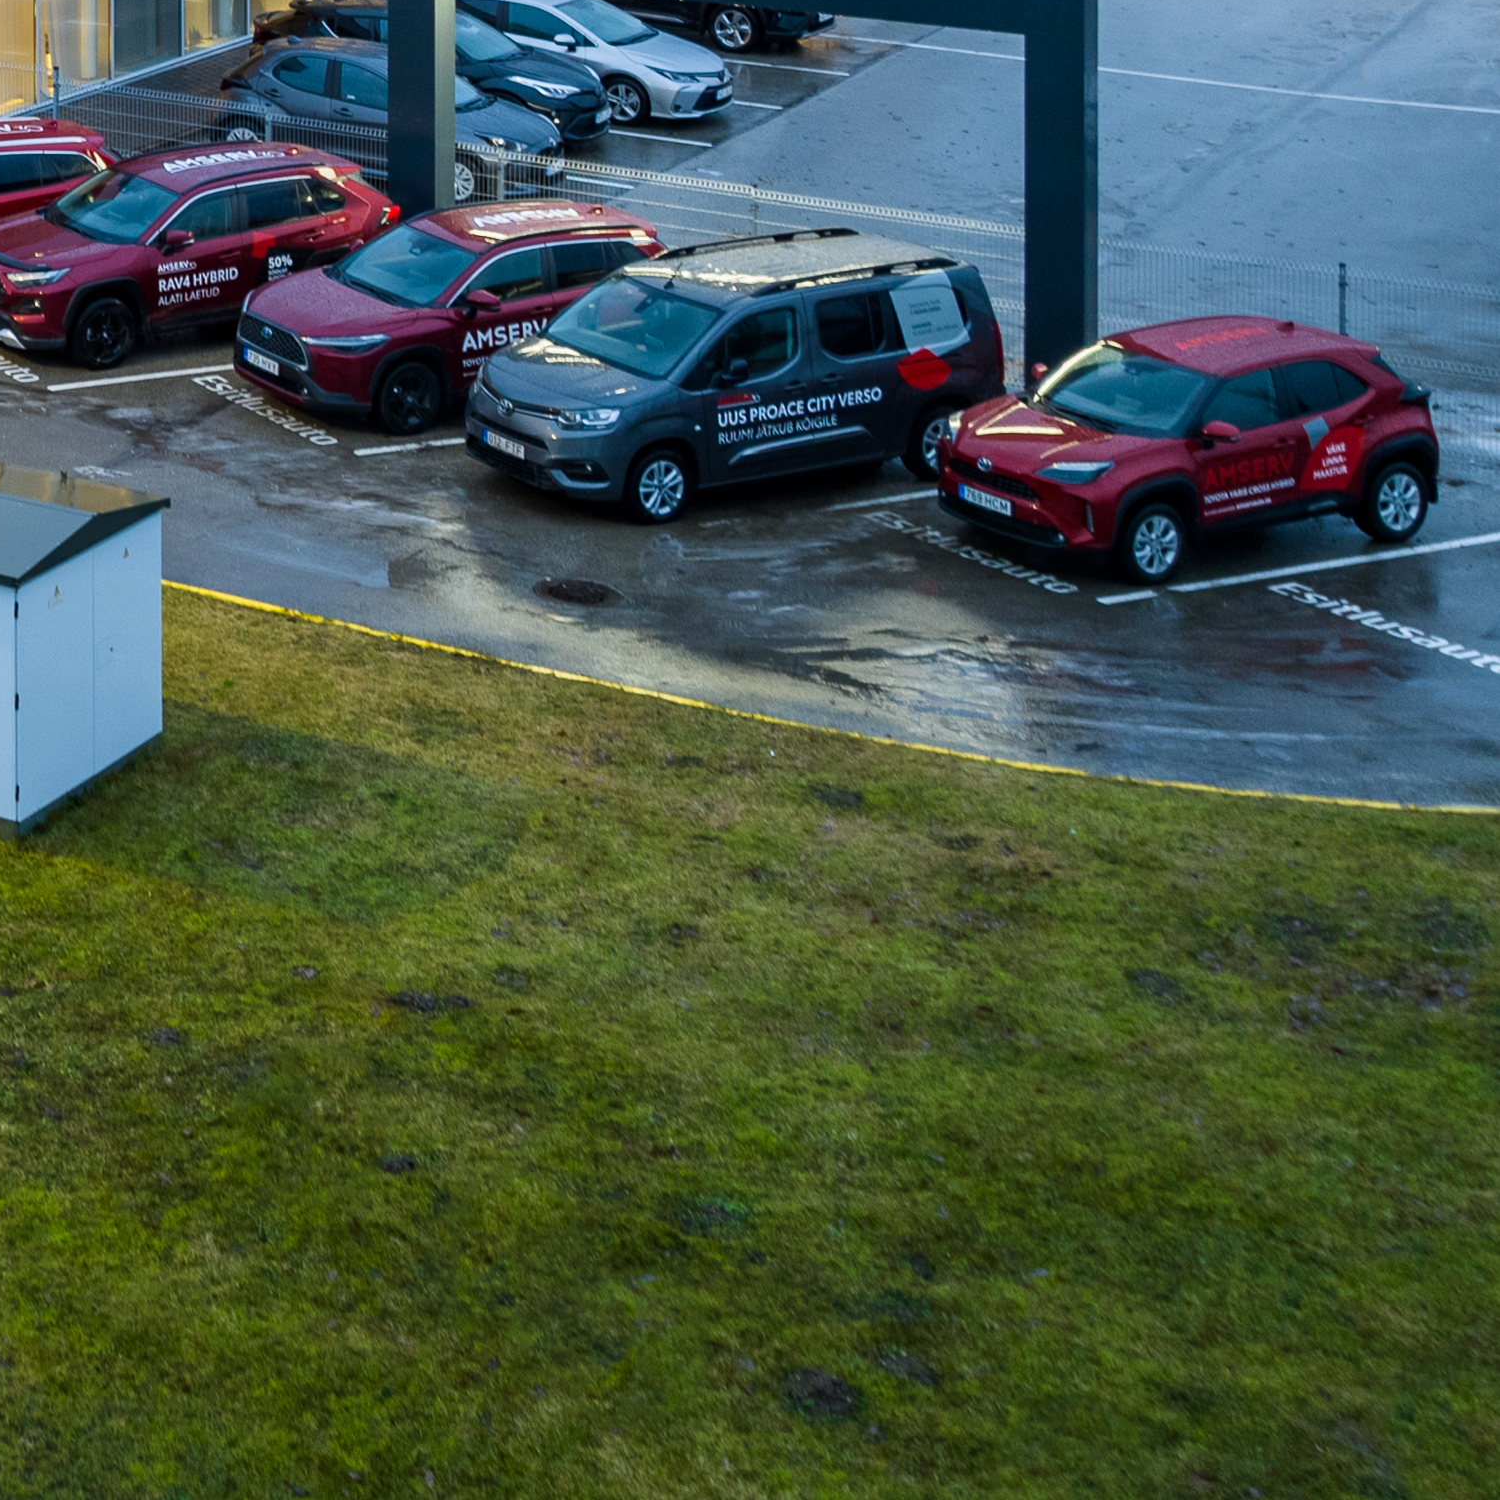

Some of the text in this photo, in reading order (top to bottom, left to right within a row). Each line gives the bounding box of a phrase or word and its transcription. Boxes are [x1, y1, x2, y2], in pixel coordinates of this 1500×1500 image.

[163, 149, 257, 174] AMSERV
[268, 254, 293, 269] 50%
[158, 266, 239, 293] RAV4 HYBRID
[158, 286, 220, 307] ALATI LAETUD
[462, 317, 548, 352] AMSERV
[191, 374, 338, 446] Esitlusauto
[718, 386, 883, 428] UUS PROACE CITY VERSO
[718, 428, 753, 445] RUUMI
[755, 418, 794, 440] JÄTKUB
[1205, 452, 1295, 490] AMSERV
[1313, 464, 1349, 480] MAASTUR
[861, 510, 1079, 594] Esitlusauto
